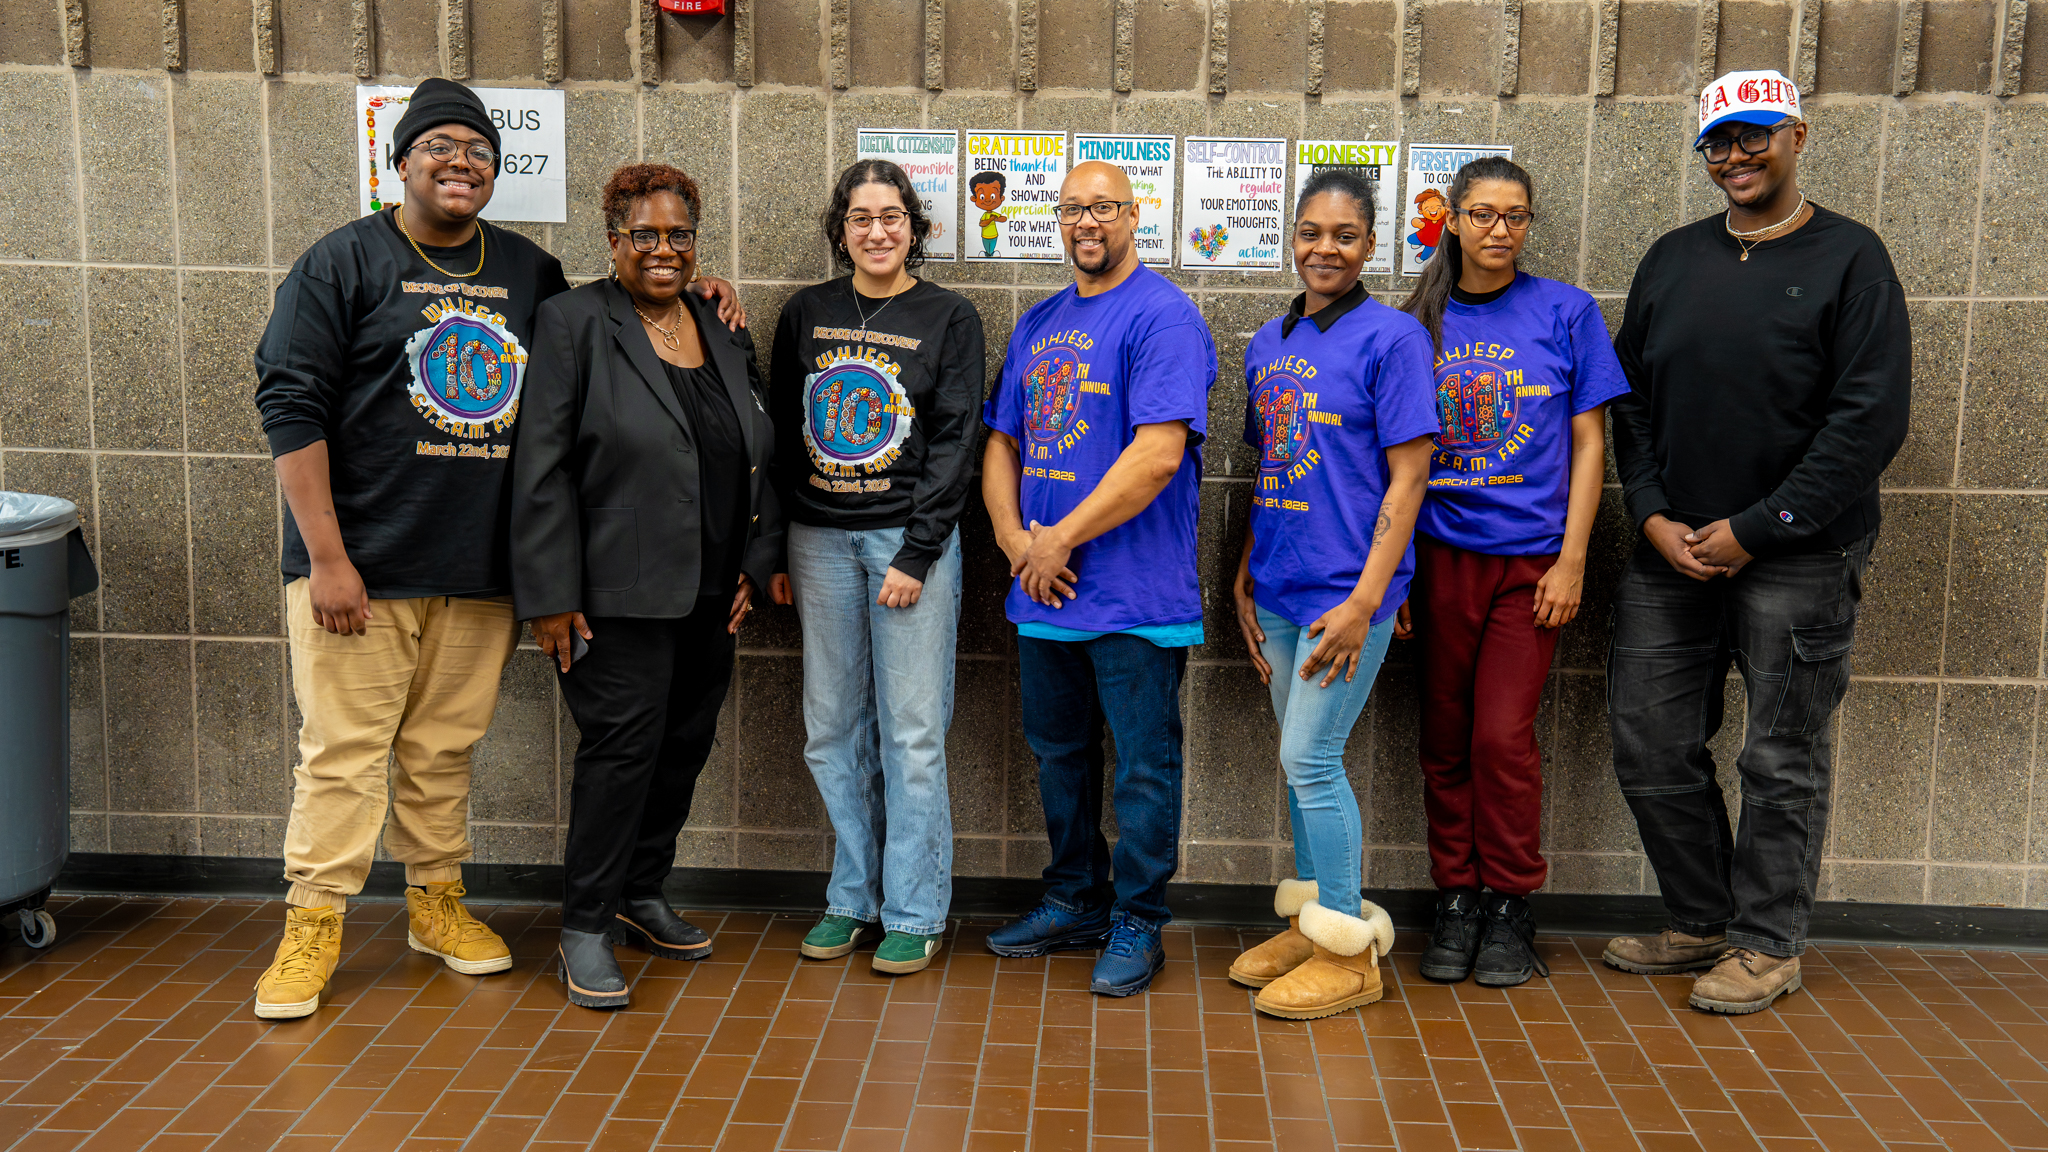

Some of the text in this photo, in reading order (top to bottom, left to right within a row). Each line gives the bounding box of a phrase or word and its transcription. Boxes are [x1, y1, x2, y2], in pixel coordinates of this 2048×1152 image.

[674, 1, 702, 10] FIRE
[490, 108, 541, 131] BUS
[859, 135, 956, 154] DIGITAL CITIZENSHIP
[968, 136, 1064, 156] GRATITUDE
[1079, 140, 1170, 161] MINDFULNESS
[1187, 142, 1283, 164] SELF-CONTROL
[1299, 144, 1397, 165] HONESTY
[504, 153, 549, 175] 627
[900, 161, 955, 180] esponsible
[974, 157, 1057, 172] BEING thankful
[1139, 166, 1163, 177] WHAT
[1207, 166, 1282, 179] THE ABILITY TO
[1025, 173, 1045, 185] AND
[1423, 173, 1435, 184] TO
[1011, 189, 1059, 202] SHOWING
[1240, 181, 1282, 199] regulate
[1134, 195, 1162, 210] ensing
[1200, 198, 1224, 210] YOUR
[1008, 220, 1057, 233] FOR WHAT
[1226, 216, 1280, 230] THOUGHTS,
[1008, 235, 1055, 249] YOU HAVE.
[1259, 233, 1280, 245] AND
[1238, 246, 1279, 259] actions.
[401, 281, 446, 294] DECADE
[443, 283, 461, 293] OF
[421, 296, 507, 326] WHJESP
[812, 326, 922, 350] DECADE OF DISCOVERY
[1031, 329, 1095, 355] WHJESP
[431, 332, 502, 402] 10
[815, 345, 902, 377] WHJESP
[1254, 354, 1318, 386] WHJESP
[1504, 368, 1524, 386] TH
[1026, 360, 1091, 431] 11 TH
[1079, 380, 1112, 395] ANNUAL
[1515, 384, 1552, 398] ANNUAL
[1302, 392, 1318, 409] TH
[1477, 392, 1493, 405] TH
[409, 393, 491, 439] S.T.E.A.M.
[816, 380, 883, 446] 10
[1277, 413, 1289, 425] TH
[1307, 410, 1343, 427] ANNUAL
[1058, 419, 1091, 455] FAIR
[1498, 423, 1535, 461] FAIR
[416, 441, 457, 456] March
[458, 442, 491, 459] 22nd,
[1048, 469, 1076, 482] 2026
[1287, 449, 1322, 485] FAIR
[831, 480, 864, 494] 22nd,
[863, 477, 891, 492] 2025
[1428, 474, 1524, 487] MARCH 21, 2026
[1265, 497, 1281, 509] 21,
